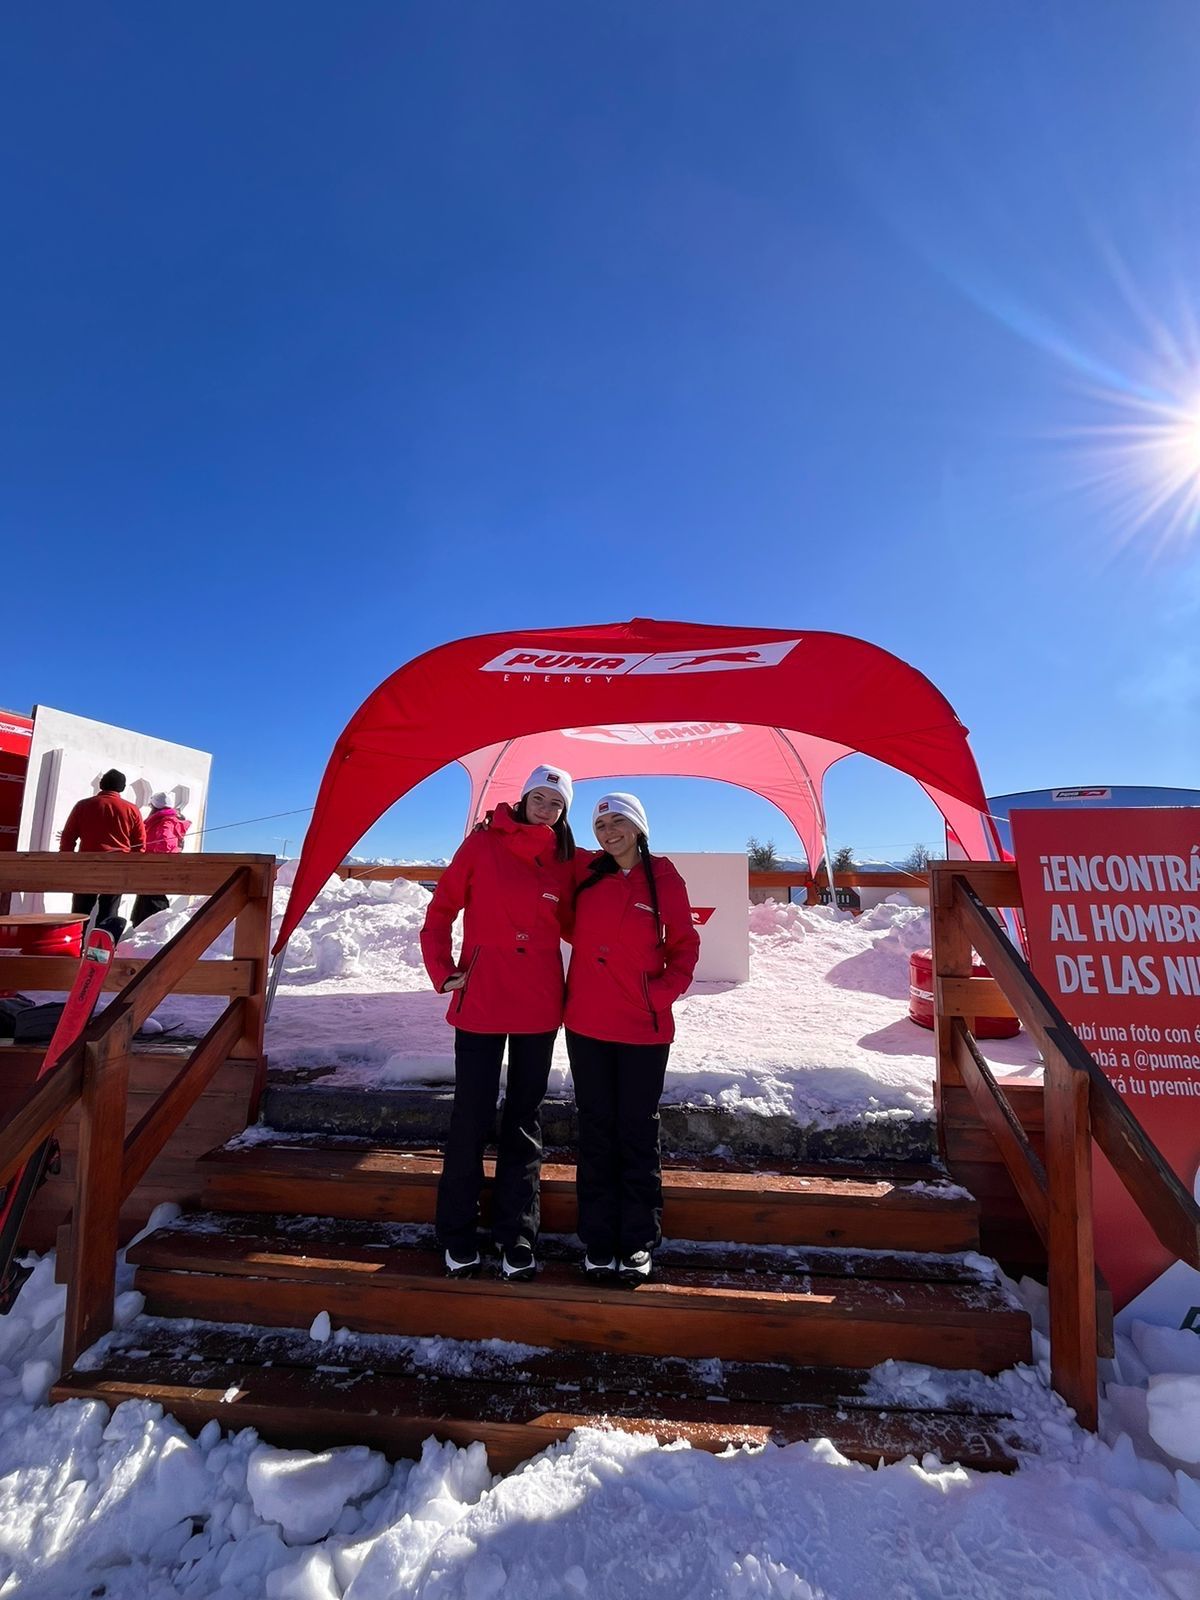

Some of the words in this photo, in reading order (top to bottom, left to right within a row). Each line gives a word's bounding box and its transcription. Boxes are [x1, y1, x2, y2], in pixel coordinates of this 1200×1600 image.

[503, 653, 626, 670] PUMA
[503, 674, 613, 684] ENERGY
[1039, 845, 1200, 892] ¡ENCONTRÁ
[1051, 904, 1088, 942] AL
[1055, 954, 1099, 994] DE
[1101, 955, 1161, 995] LAS
[1163, 956, 1200, 996] NI
[1068, 1022, 1097, 1041] ubí
[1100, 1026, 1127, 1041] una
[1130, 1024, 1161, 1043] foto
[1164, 1028, 1191, 1043] con
[1121, 1053, 1131, 1067] a
[1133, 1049, 1200, 1071] @pumae
[1129, 1076, 1146, 1095] tu
